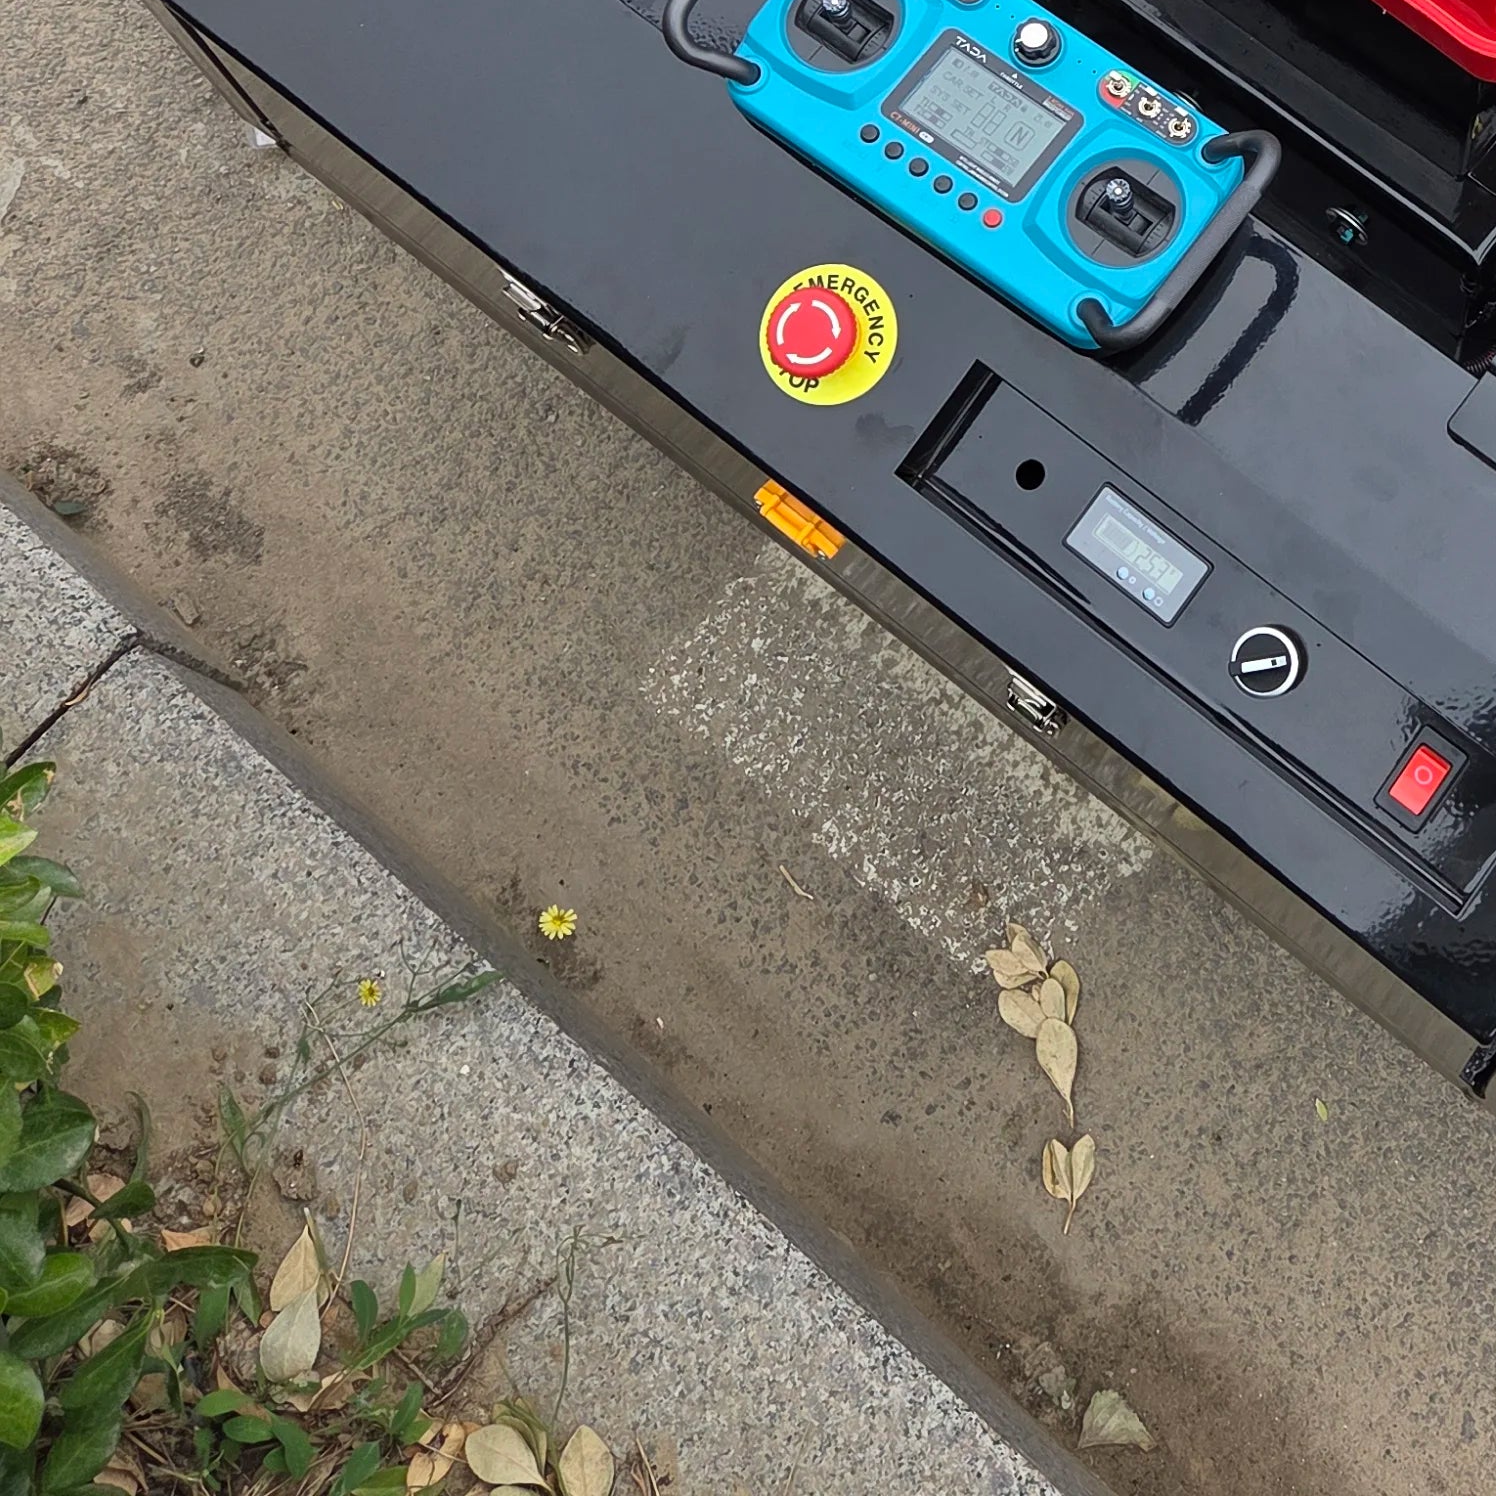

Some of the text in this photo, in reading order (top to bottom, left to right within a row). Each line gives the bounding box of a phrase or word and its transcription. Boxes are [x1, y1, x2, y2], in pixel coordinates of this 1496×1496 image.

[955, 35, 987, 64] TADA
[943, 70, 965, 89] CAR
[962, 84, 985, 101] SET
[1011, 127, 1026, 145] N
[793, 275, 884, 364] MERGENCY
